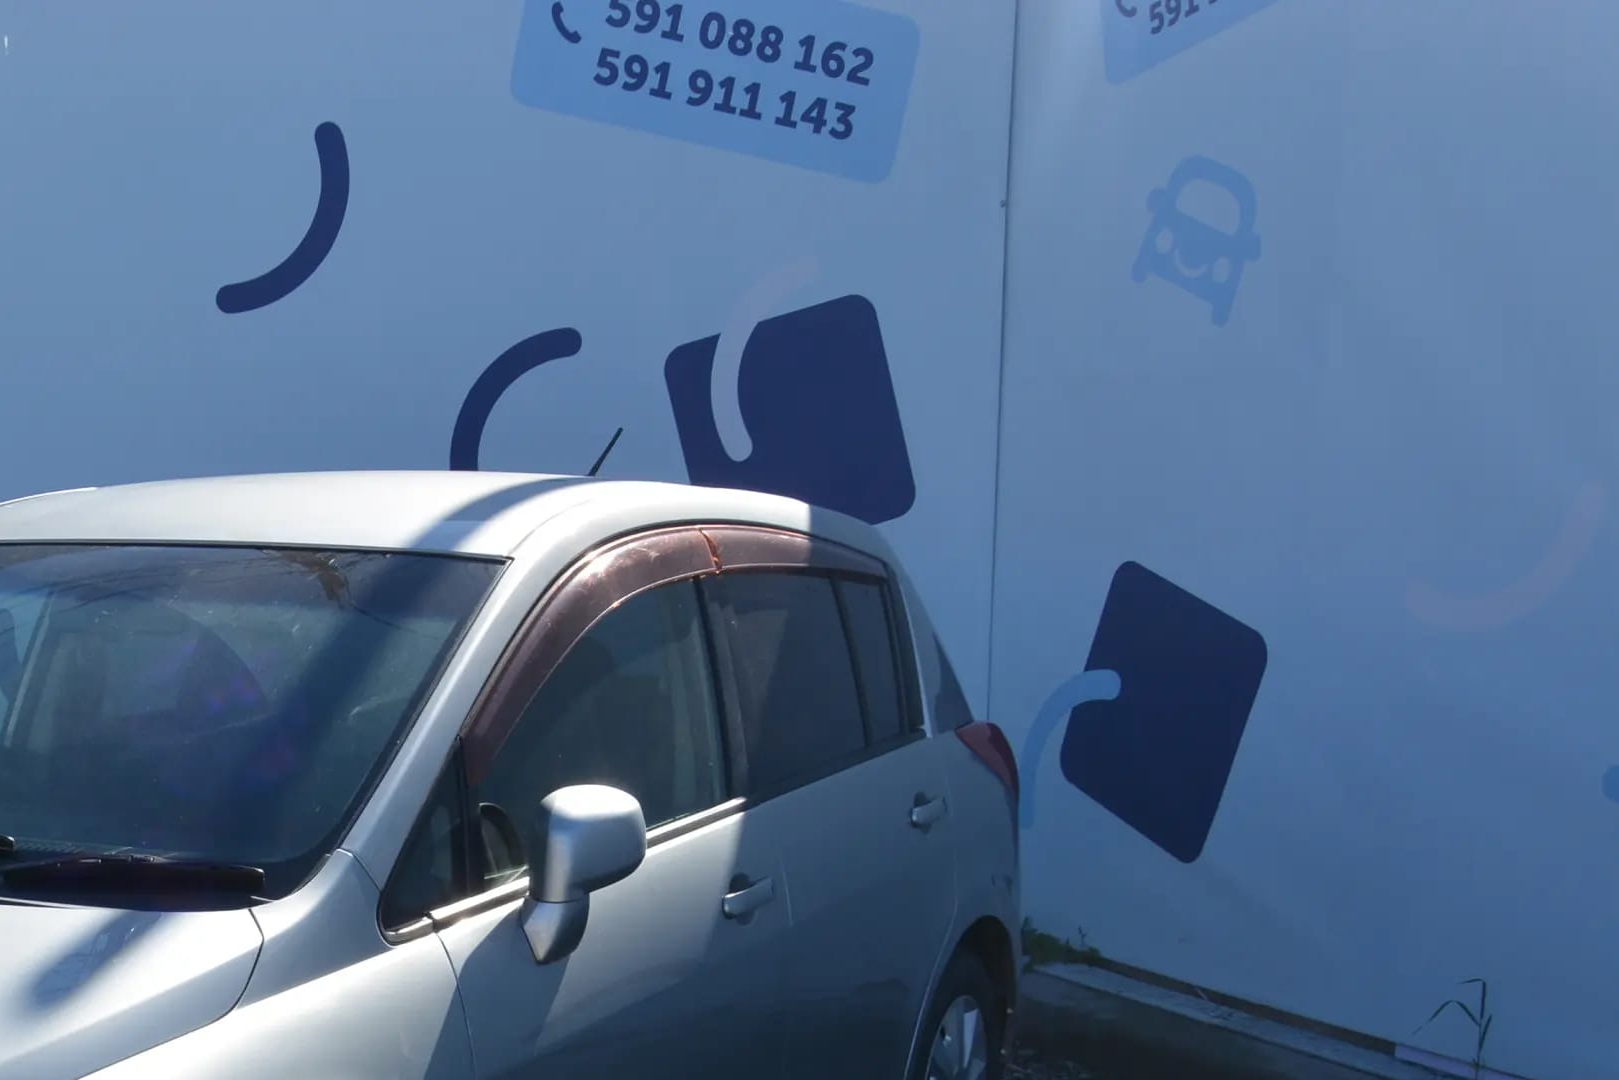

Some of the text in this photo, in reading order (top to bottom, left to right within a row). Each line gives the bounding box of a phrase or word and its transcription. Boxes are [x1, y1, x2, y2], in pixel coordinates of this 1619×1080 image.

[605, 0, 874, 86] 591 088 162
[593, 47, 856, 140] 591 911 143
